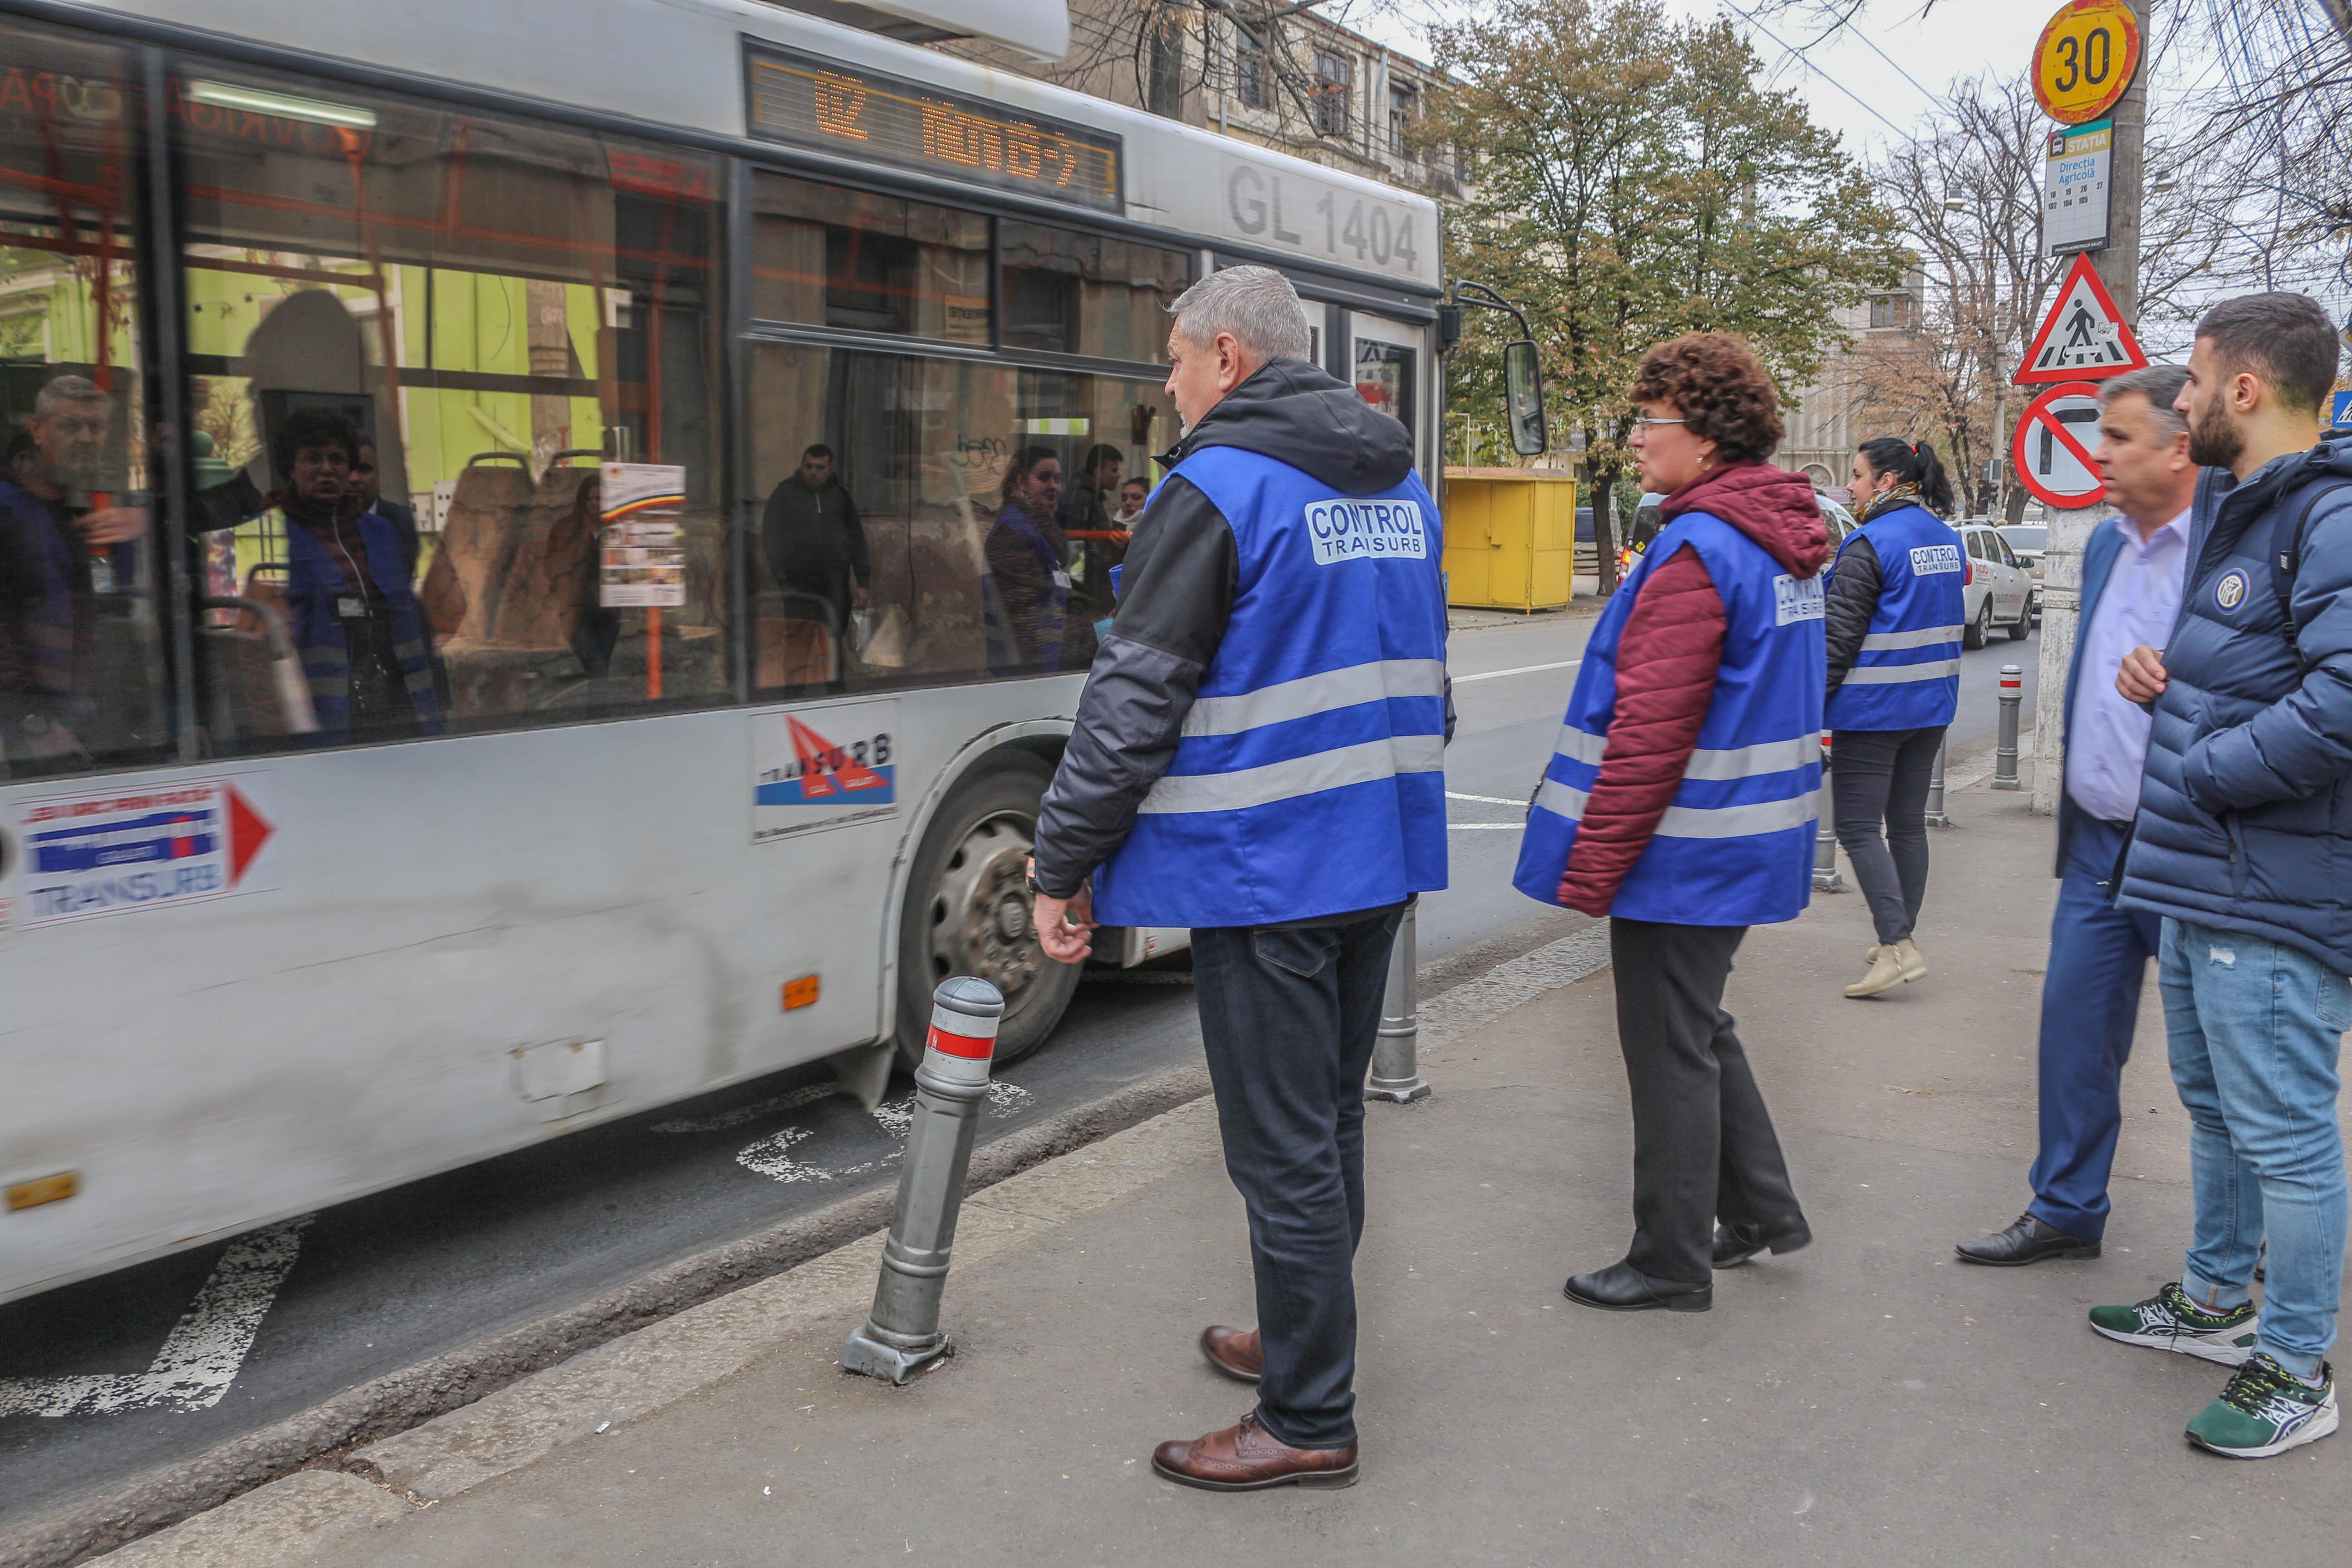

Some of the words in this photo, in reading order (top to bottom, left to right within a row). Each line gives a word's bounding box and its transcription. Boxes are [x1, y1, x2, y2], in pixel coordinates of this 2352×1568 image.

[2055, 27, 2110, 92] 30
[2060, 157, 2095, 173] Direcția
[2058, 167, 2095, 185] Agricolă
[2050, 191, 2056, 199] 18
[2065, 188, 2071, 196] 19
[2080, 185, 2087, 193] 26
[2097, 181, 2103, 190] 27
[2048, 202, 2057, 210] 102
[2063, 199, 2072, 207] 104
[2078, 196, 2088, 204] 105
[1228, 166, 1301, 245] GL
[1318, 191, 1416, 272] 1404
[1312, 504, 1421, 539] CONTROL
[1913, 548, 1958, 564] CONTROL
